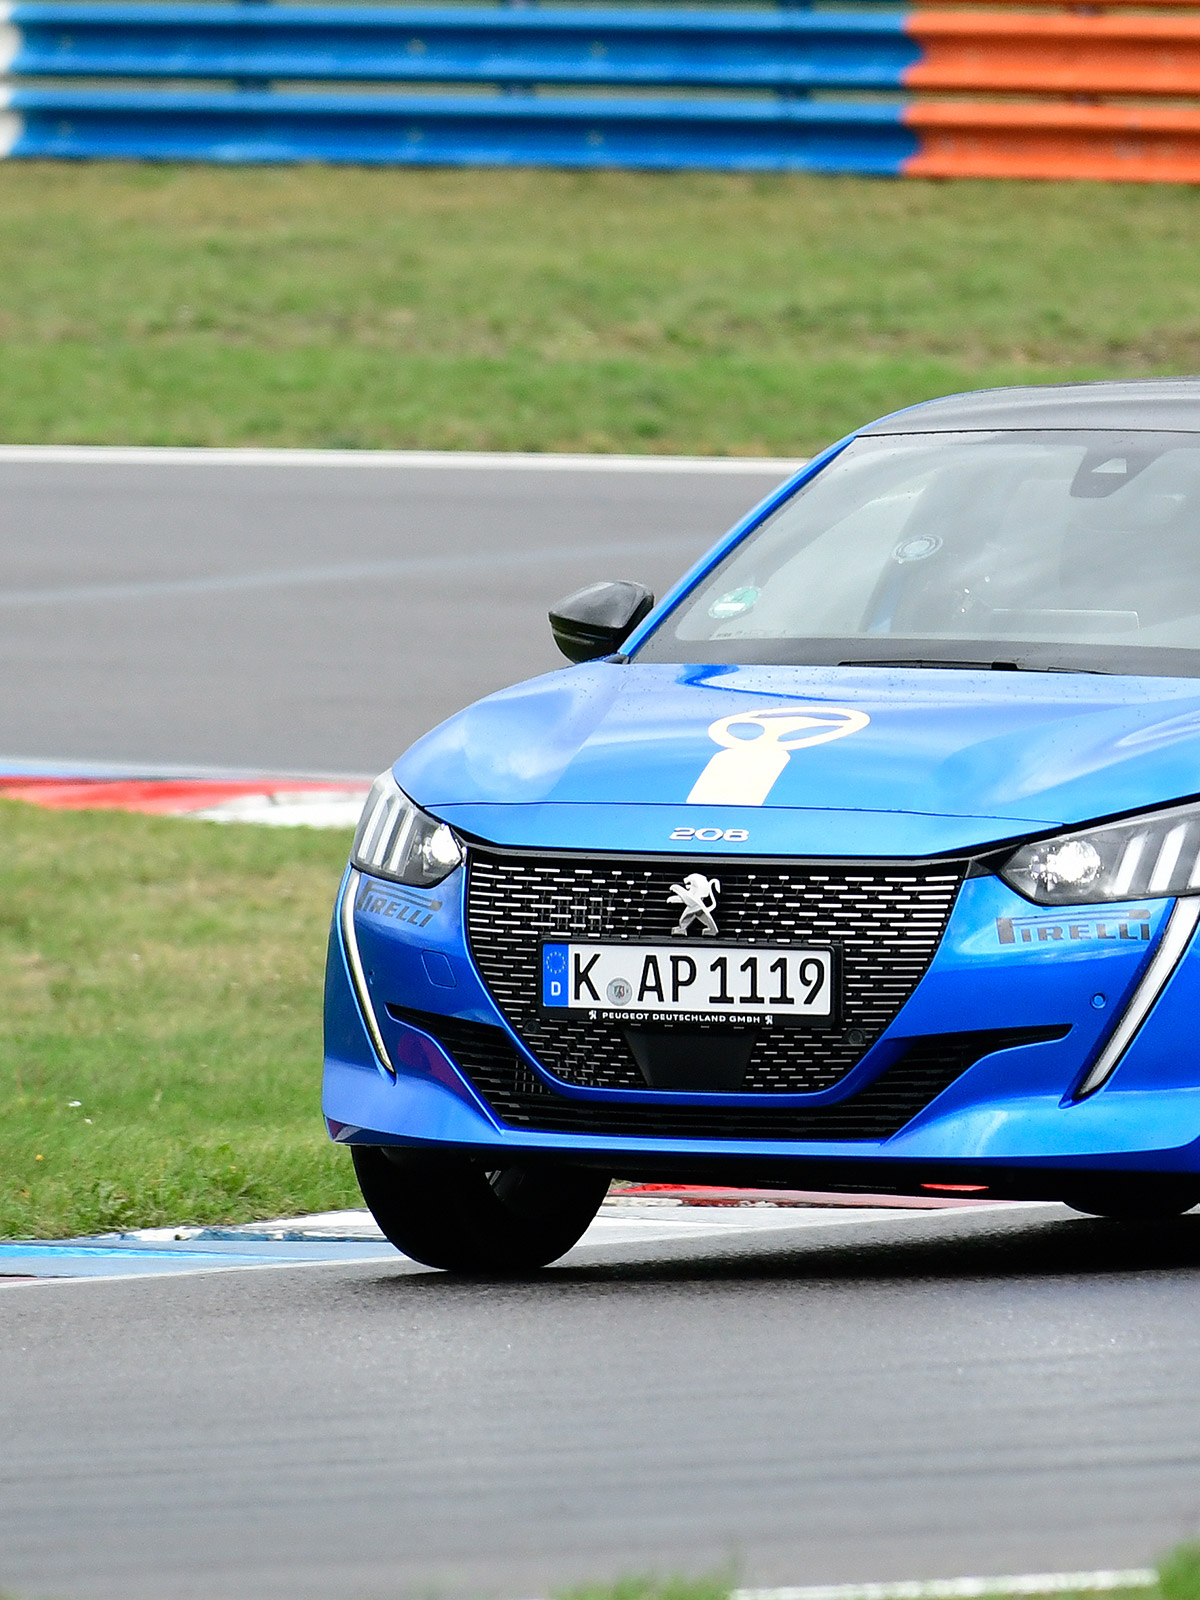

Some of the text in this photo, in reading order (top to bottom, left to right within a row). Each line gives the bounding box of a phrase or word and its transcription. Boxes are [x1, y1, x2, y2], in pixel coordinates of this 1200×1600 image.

[669, 827, 750, 842] 208
[356, 880, 443, 928] PIRELLI
[996, 909, 1152, 945] PIRELLI
[550, 981, 562, 997] D
[573, 953, 602, 1001] K
[637, 954, 698, 1003] AP
[708, 956, 826, 1005] 1119
[601, 1011, 761, 1024] PEUGEOT DEUTSCHLAND GMBH
